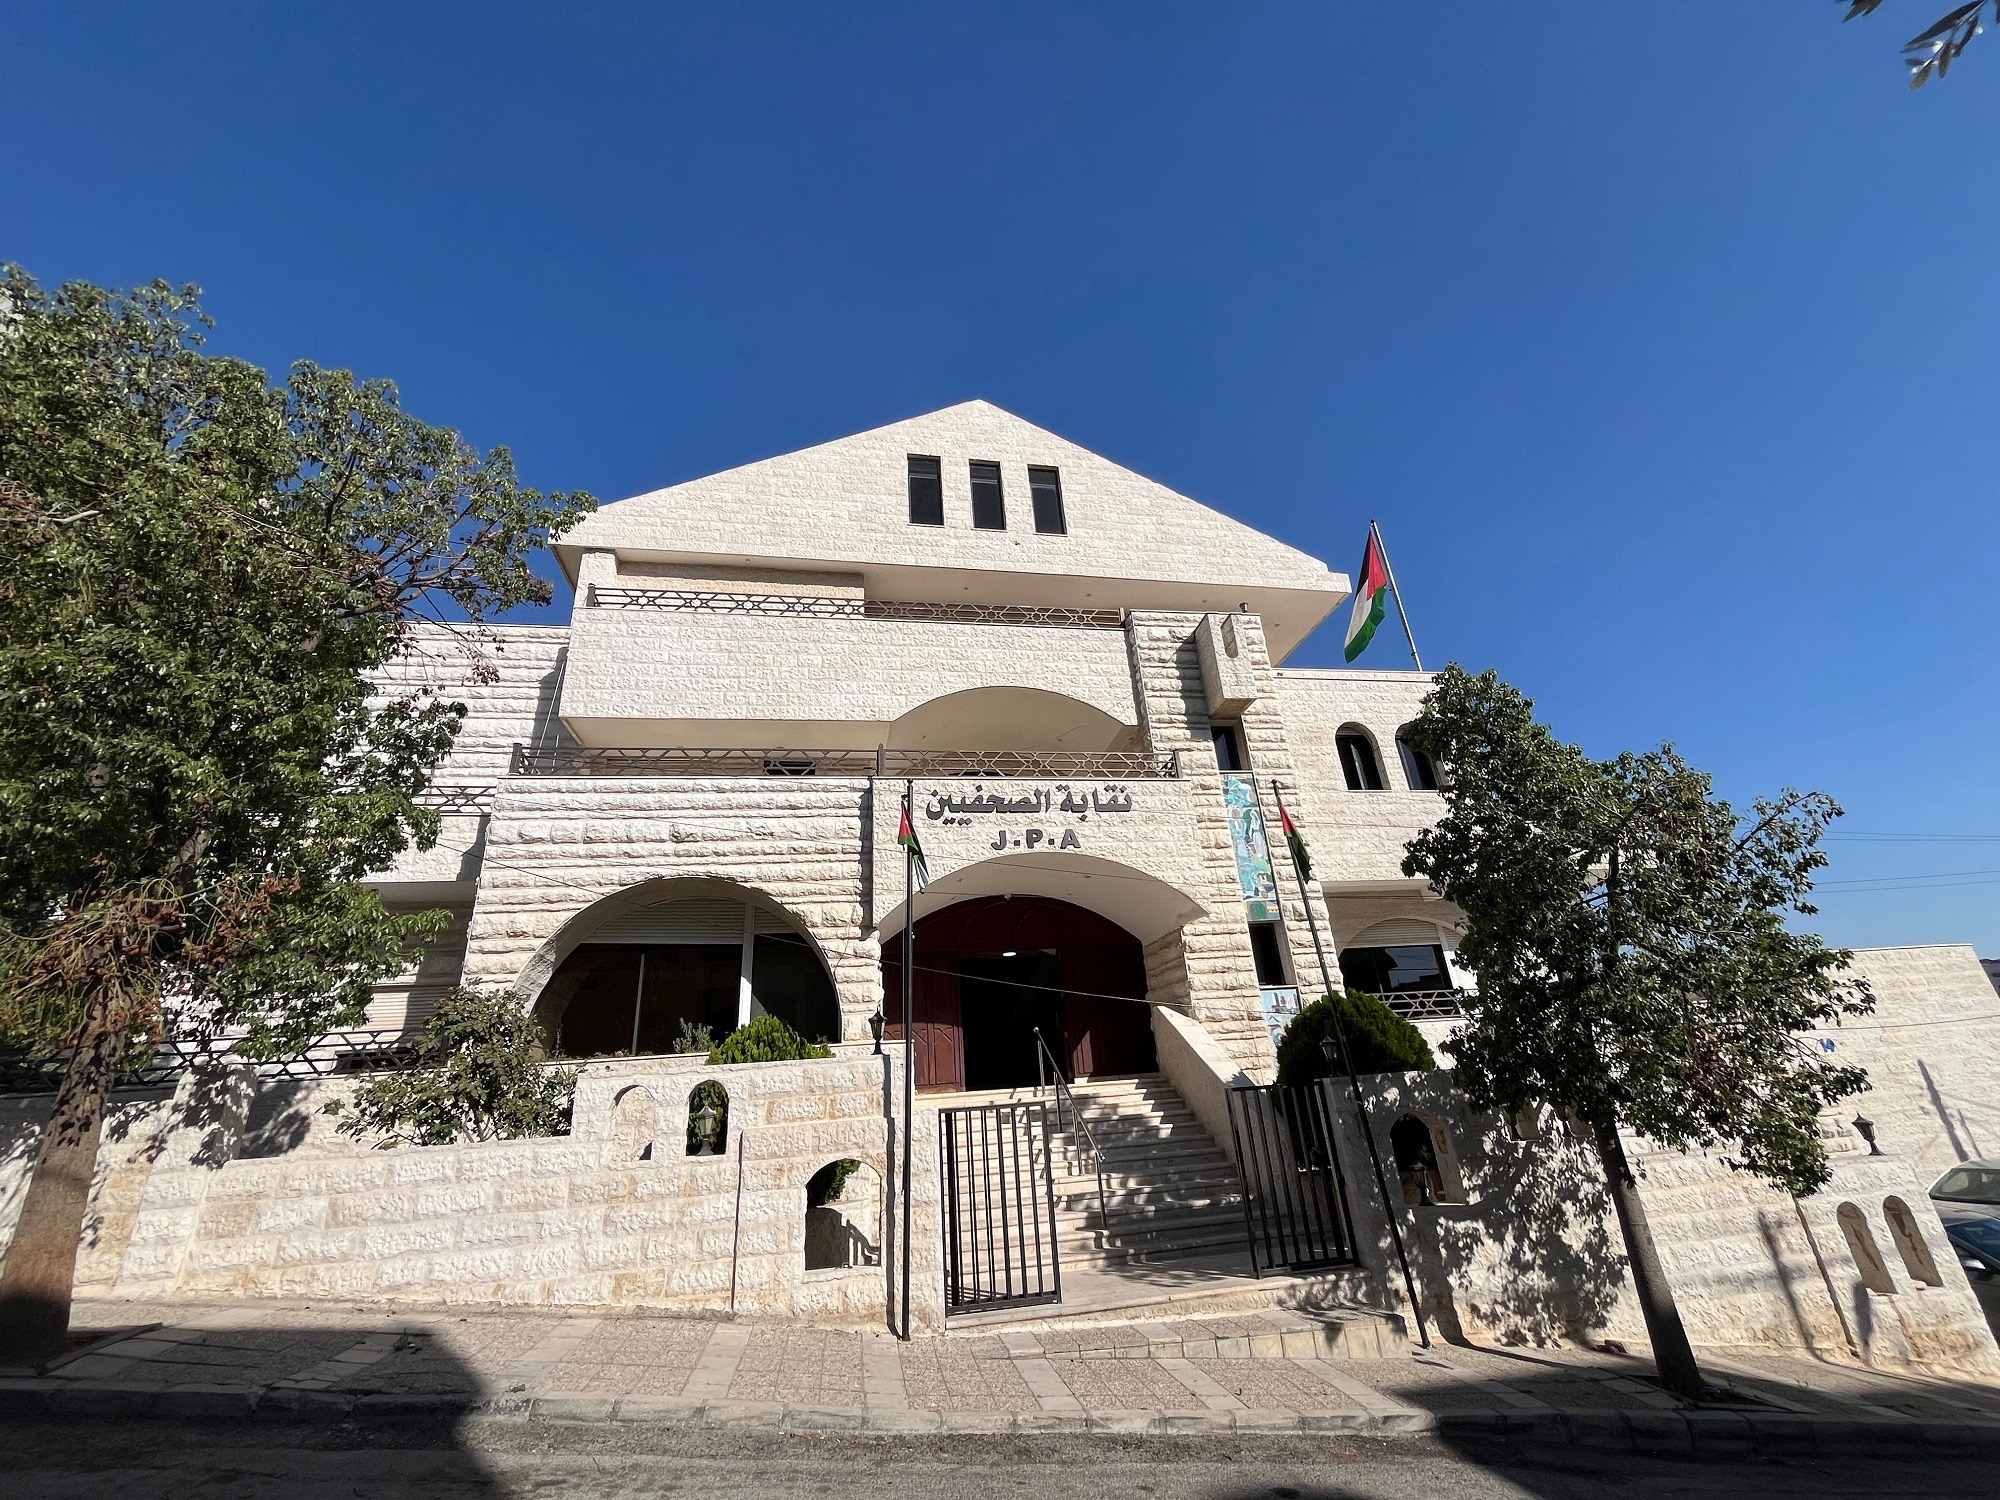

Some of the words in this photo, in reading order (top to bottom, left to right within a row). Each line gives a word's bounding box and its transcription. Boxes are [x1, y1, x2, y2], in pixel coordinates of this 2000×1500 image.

[925, 784, 1051, 826] الصحفيين
[1056, 784, 1132, 822] نقابة
[990, 829, 1081, 850] J.P.A
